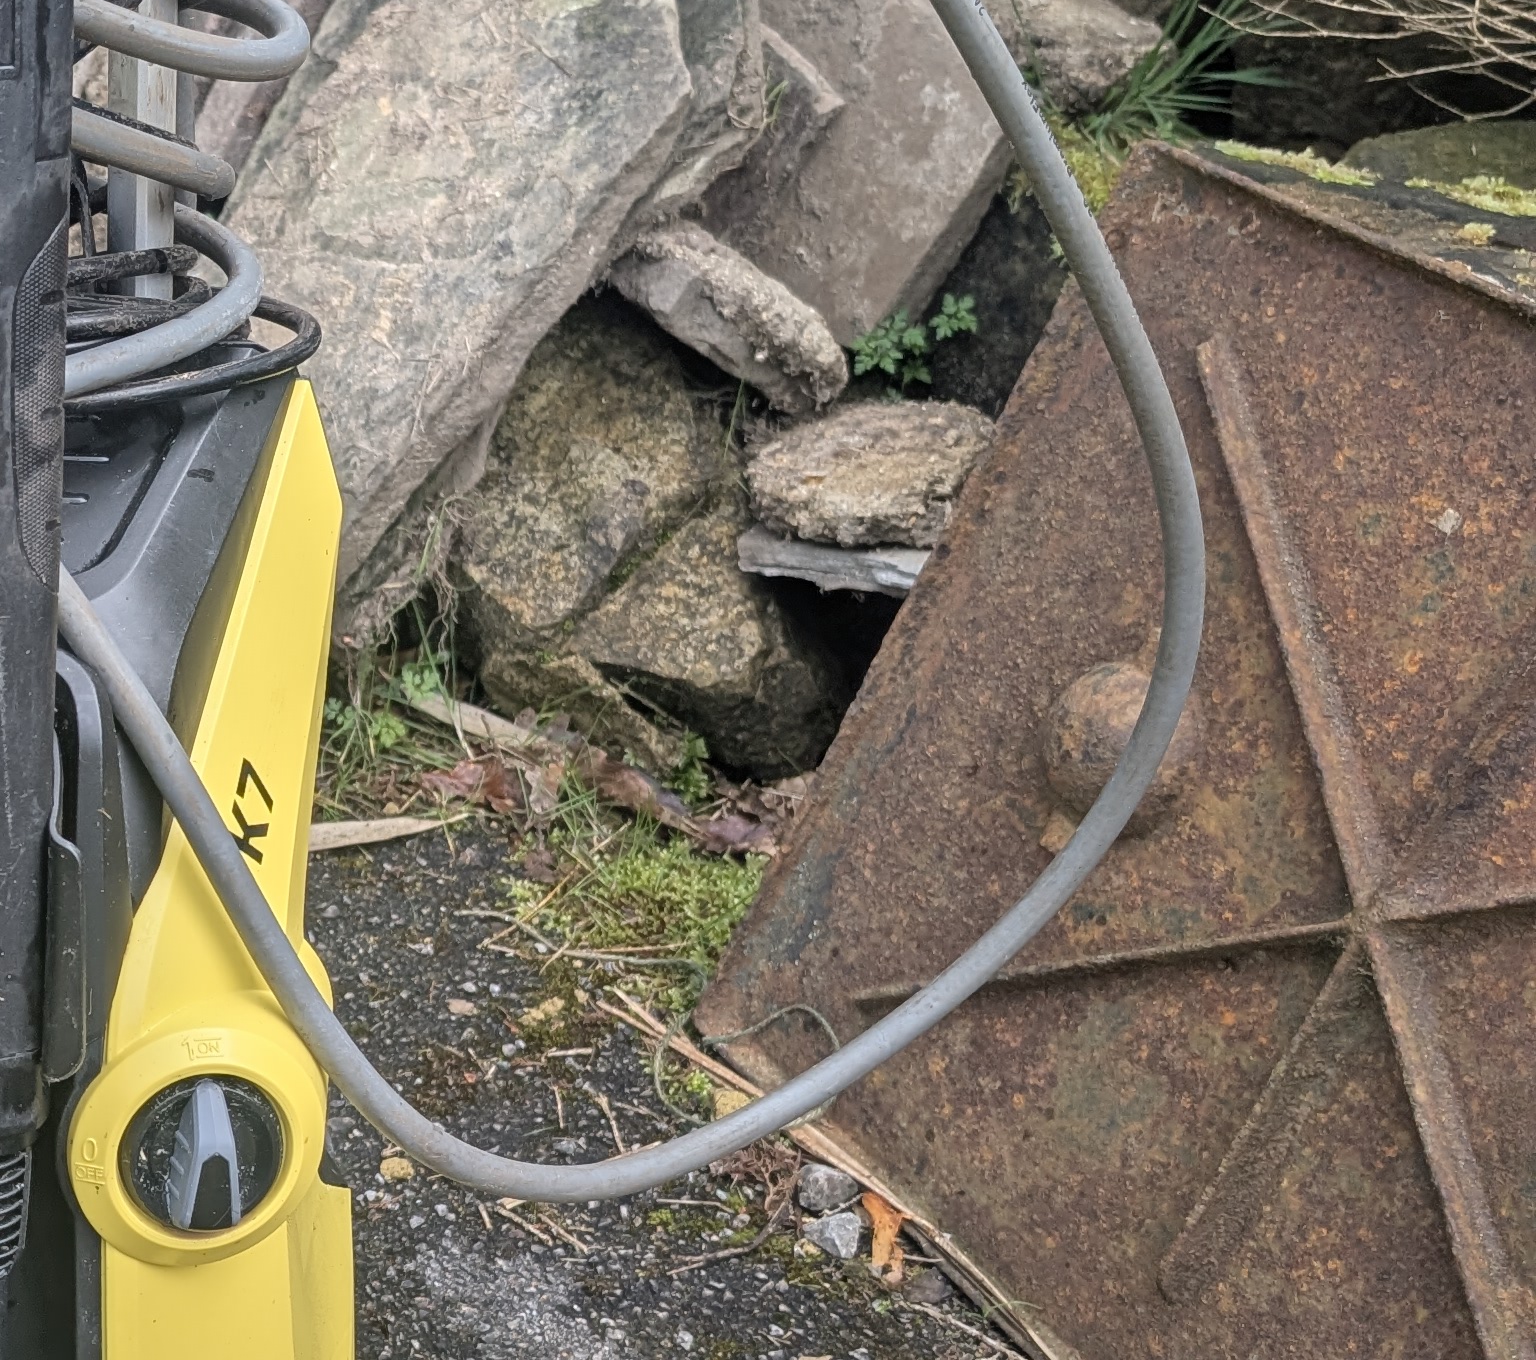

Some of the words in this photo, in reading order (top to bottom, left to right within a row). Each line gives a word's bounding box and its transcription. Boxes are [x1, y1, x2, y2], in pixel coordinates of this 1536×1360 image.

[229, 757, 274, 866] K7
[197, 1041, 221, 1055] ON
[75, 1166, 104, 1181] OFF
